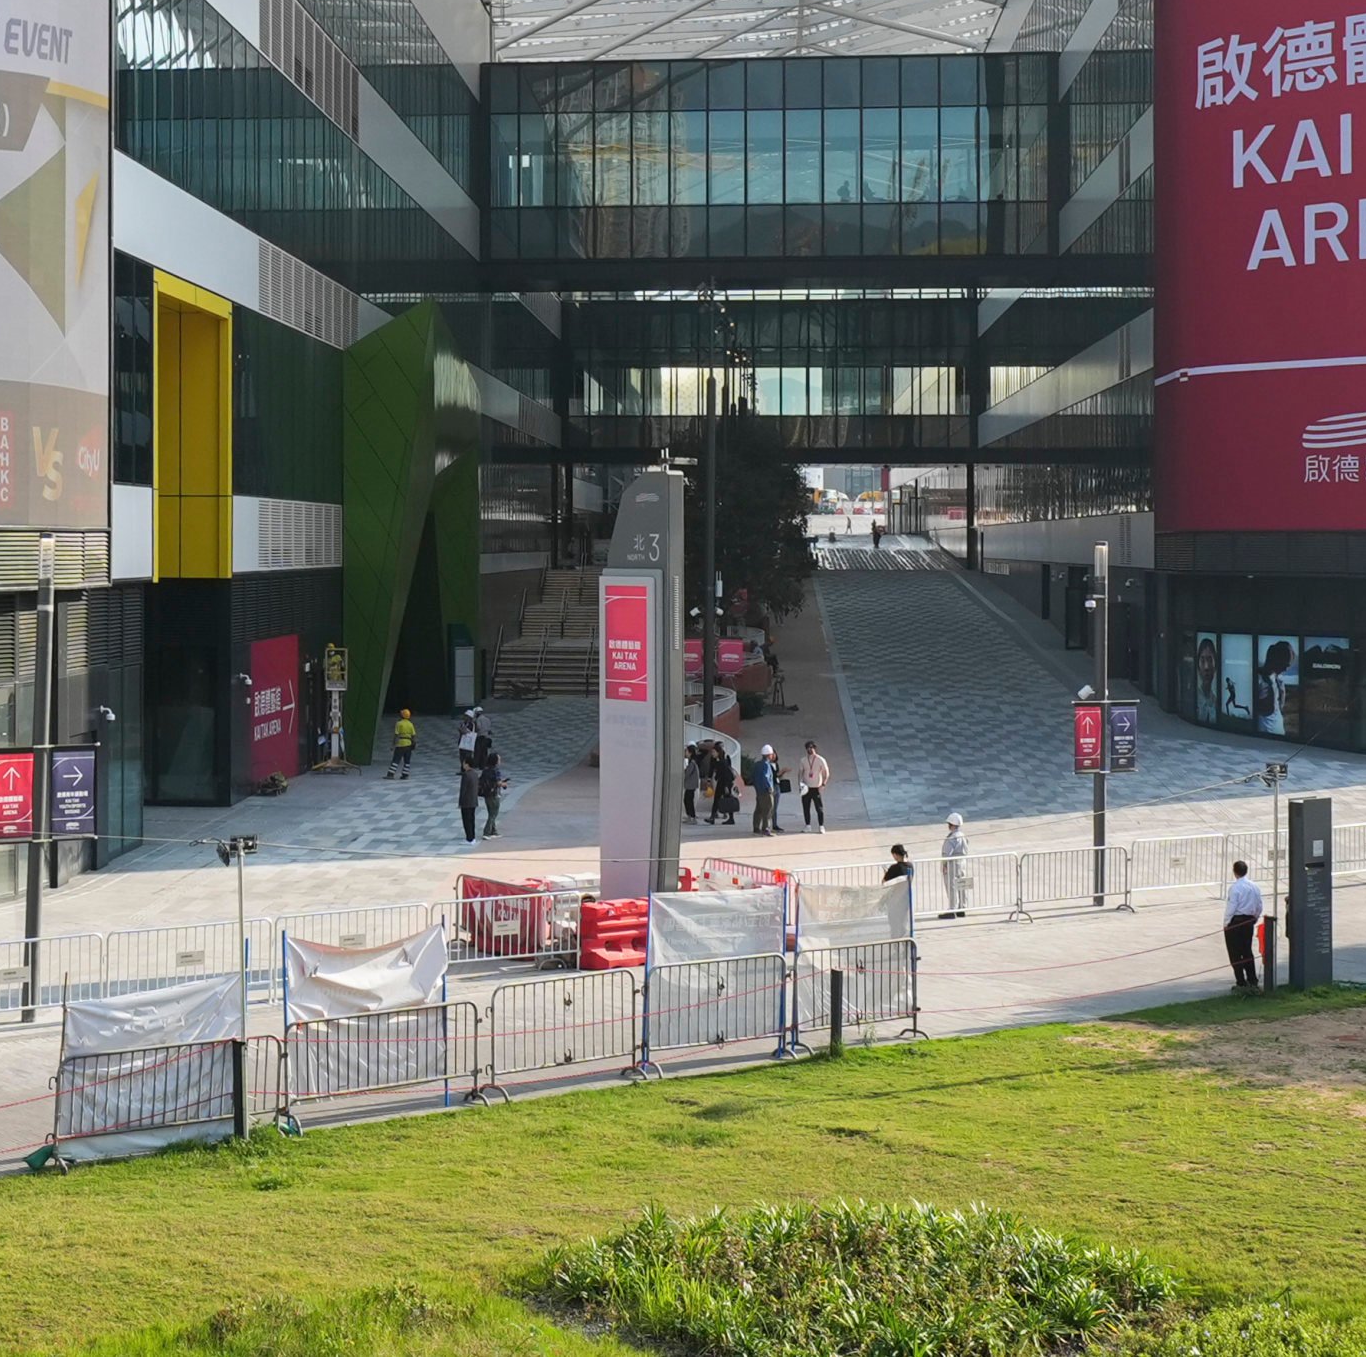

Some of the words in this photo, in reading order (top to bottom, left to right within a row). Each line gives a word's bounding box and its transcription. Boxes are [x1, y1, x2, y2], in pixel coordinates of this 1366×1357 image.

[3, 17, 73, 64] EVENT
[1232, 113, 1353, 188] KAI
[32, 426, 64, 501] VS
[1304, 454, 1360, 483] 啟德
[648, 533, 660, 562] 3
[611, 651, 624, 661] KAI
[625, 651, 638, 661] TAK
[613, 661, 637, 671] ARENA
